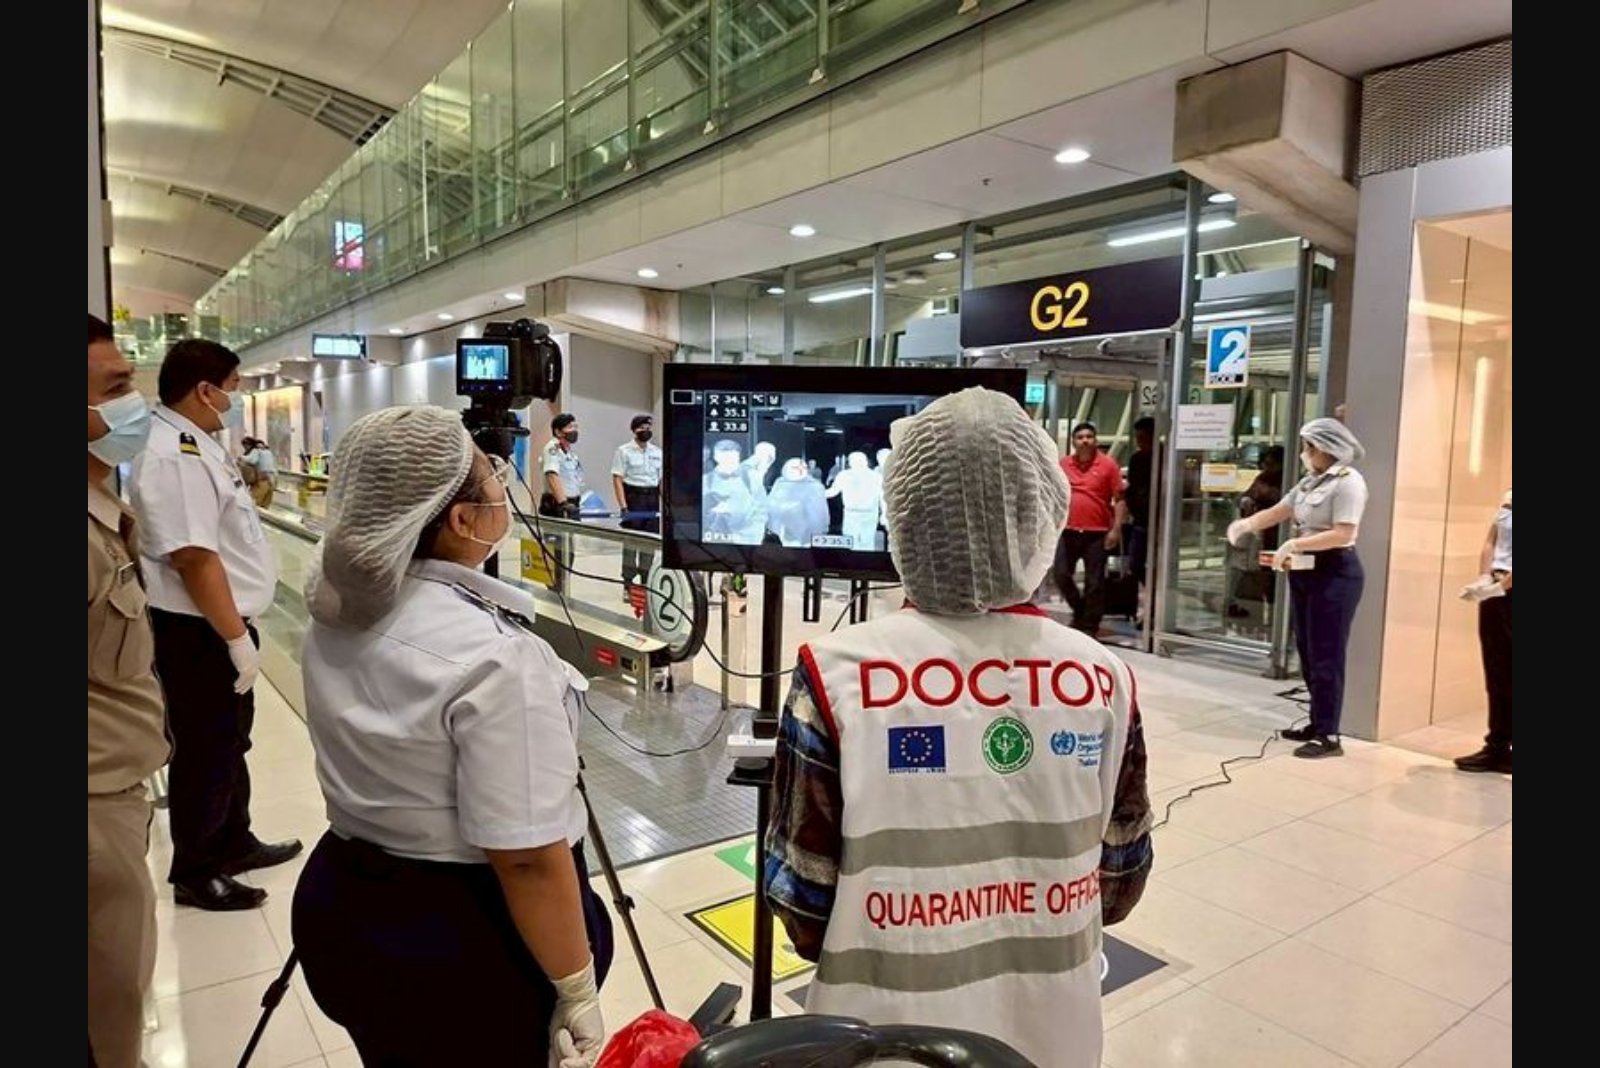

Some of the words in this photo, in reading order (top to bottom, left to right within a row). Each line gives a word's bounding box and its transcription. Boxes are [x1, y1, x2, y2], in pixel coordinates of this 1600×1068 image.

[1030, 281, 1090, 332] G2
[1217, 330, 1246, 373] 2
[724, 395, 747, 405] 34.1
[658, 574, 676, 623] 2
[859, 658, 1114, 709] DOCTOR
[866, 882, 1036, 930] QUARANTINE
